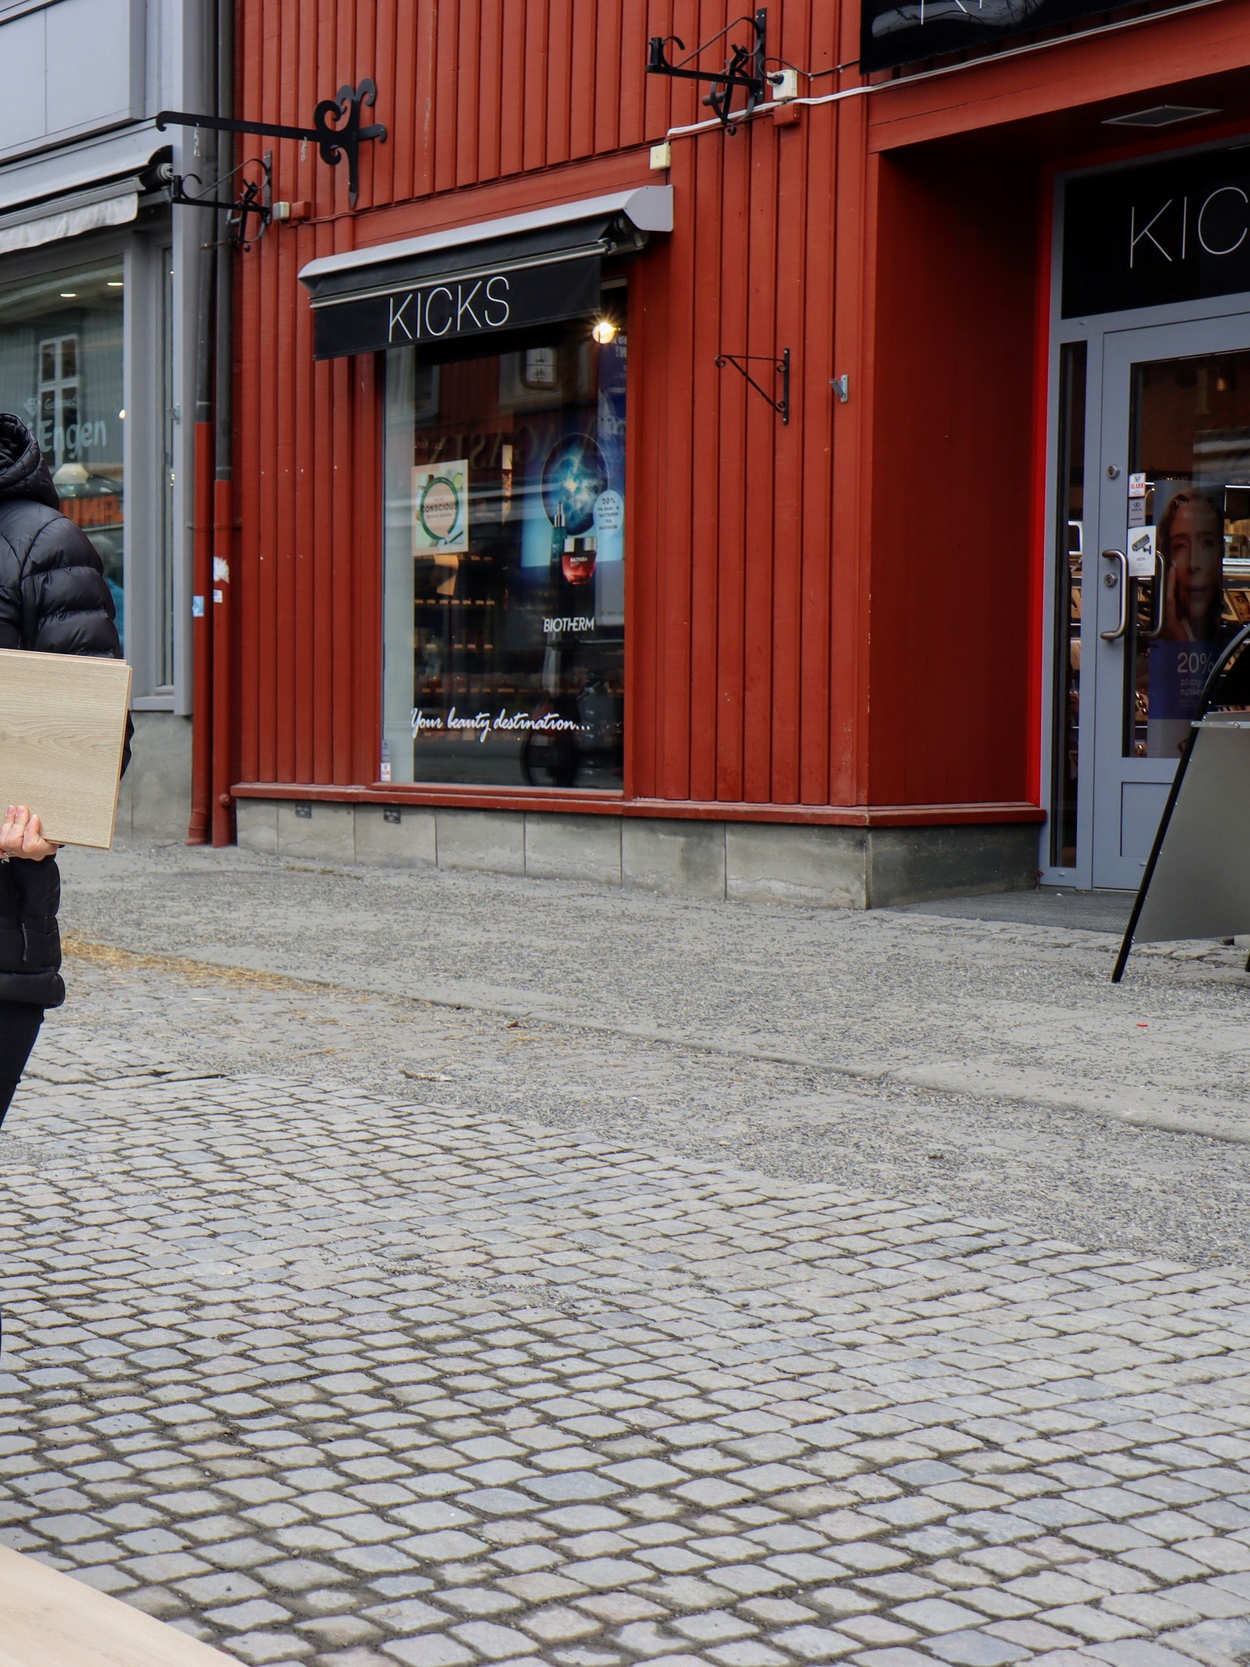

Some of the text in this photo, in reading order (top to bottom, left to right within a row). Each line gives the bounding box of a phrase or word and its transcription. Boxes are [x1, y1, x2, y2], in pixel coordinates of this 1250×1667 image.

[1129, 186, 1249, 268] KIC
[389, 276, 510, 343] KICKS
[37, 420, 106, 459] Engen
[543, 616, 595, 633] BIOTHERM
[410, 707, 443, 739] Your
[447, 706, 492, 743] beauty
